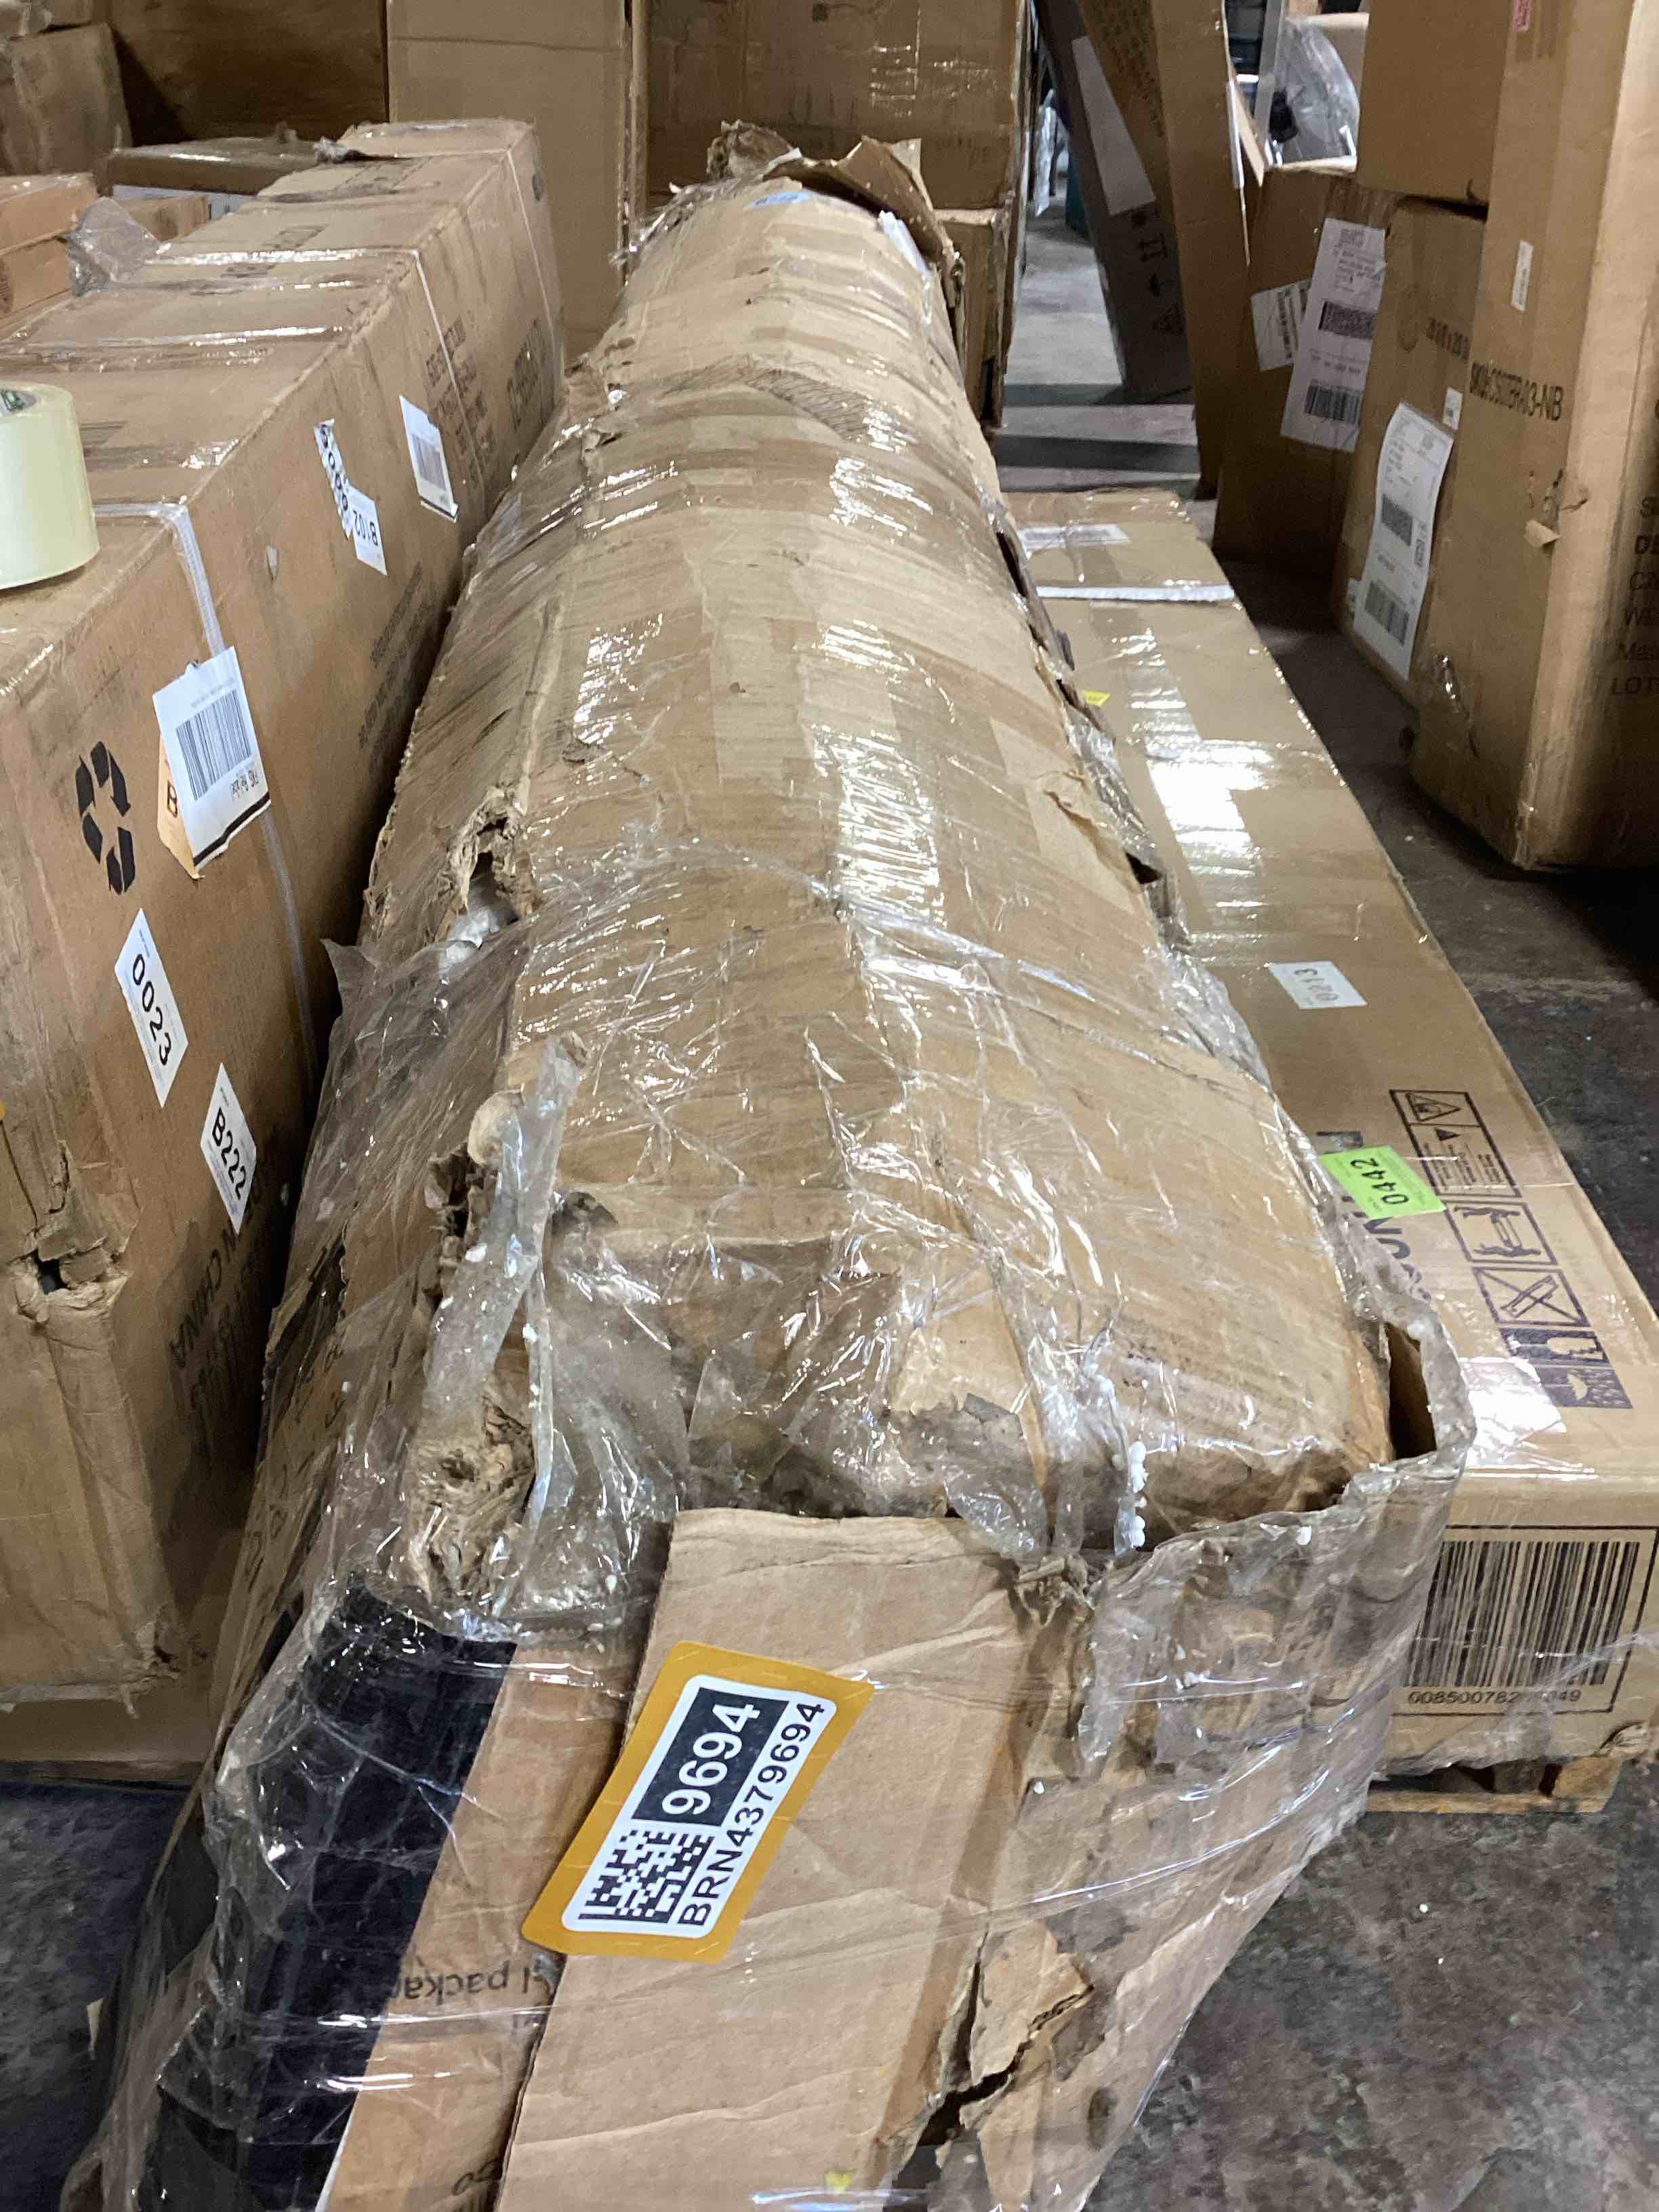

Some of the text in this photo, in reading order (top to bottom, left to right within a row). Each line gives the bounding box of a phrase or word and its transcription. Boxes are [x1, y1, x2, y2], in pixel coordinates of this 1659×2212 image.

[131, 953, 173, 1066] 0023
[211, 1106, 249, 1200] B222
[1349, 1157, 1410, 1205] 0442
[661, 1703, 761, 1816] 9694
[677, 1702, 825, 1926] BRN4379694
